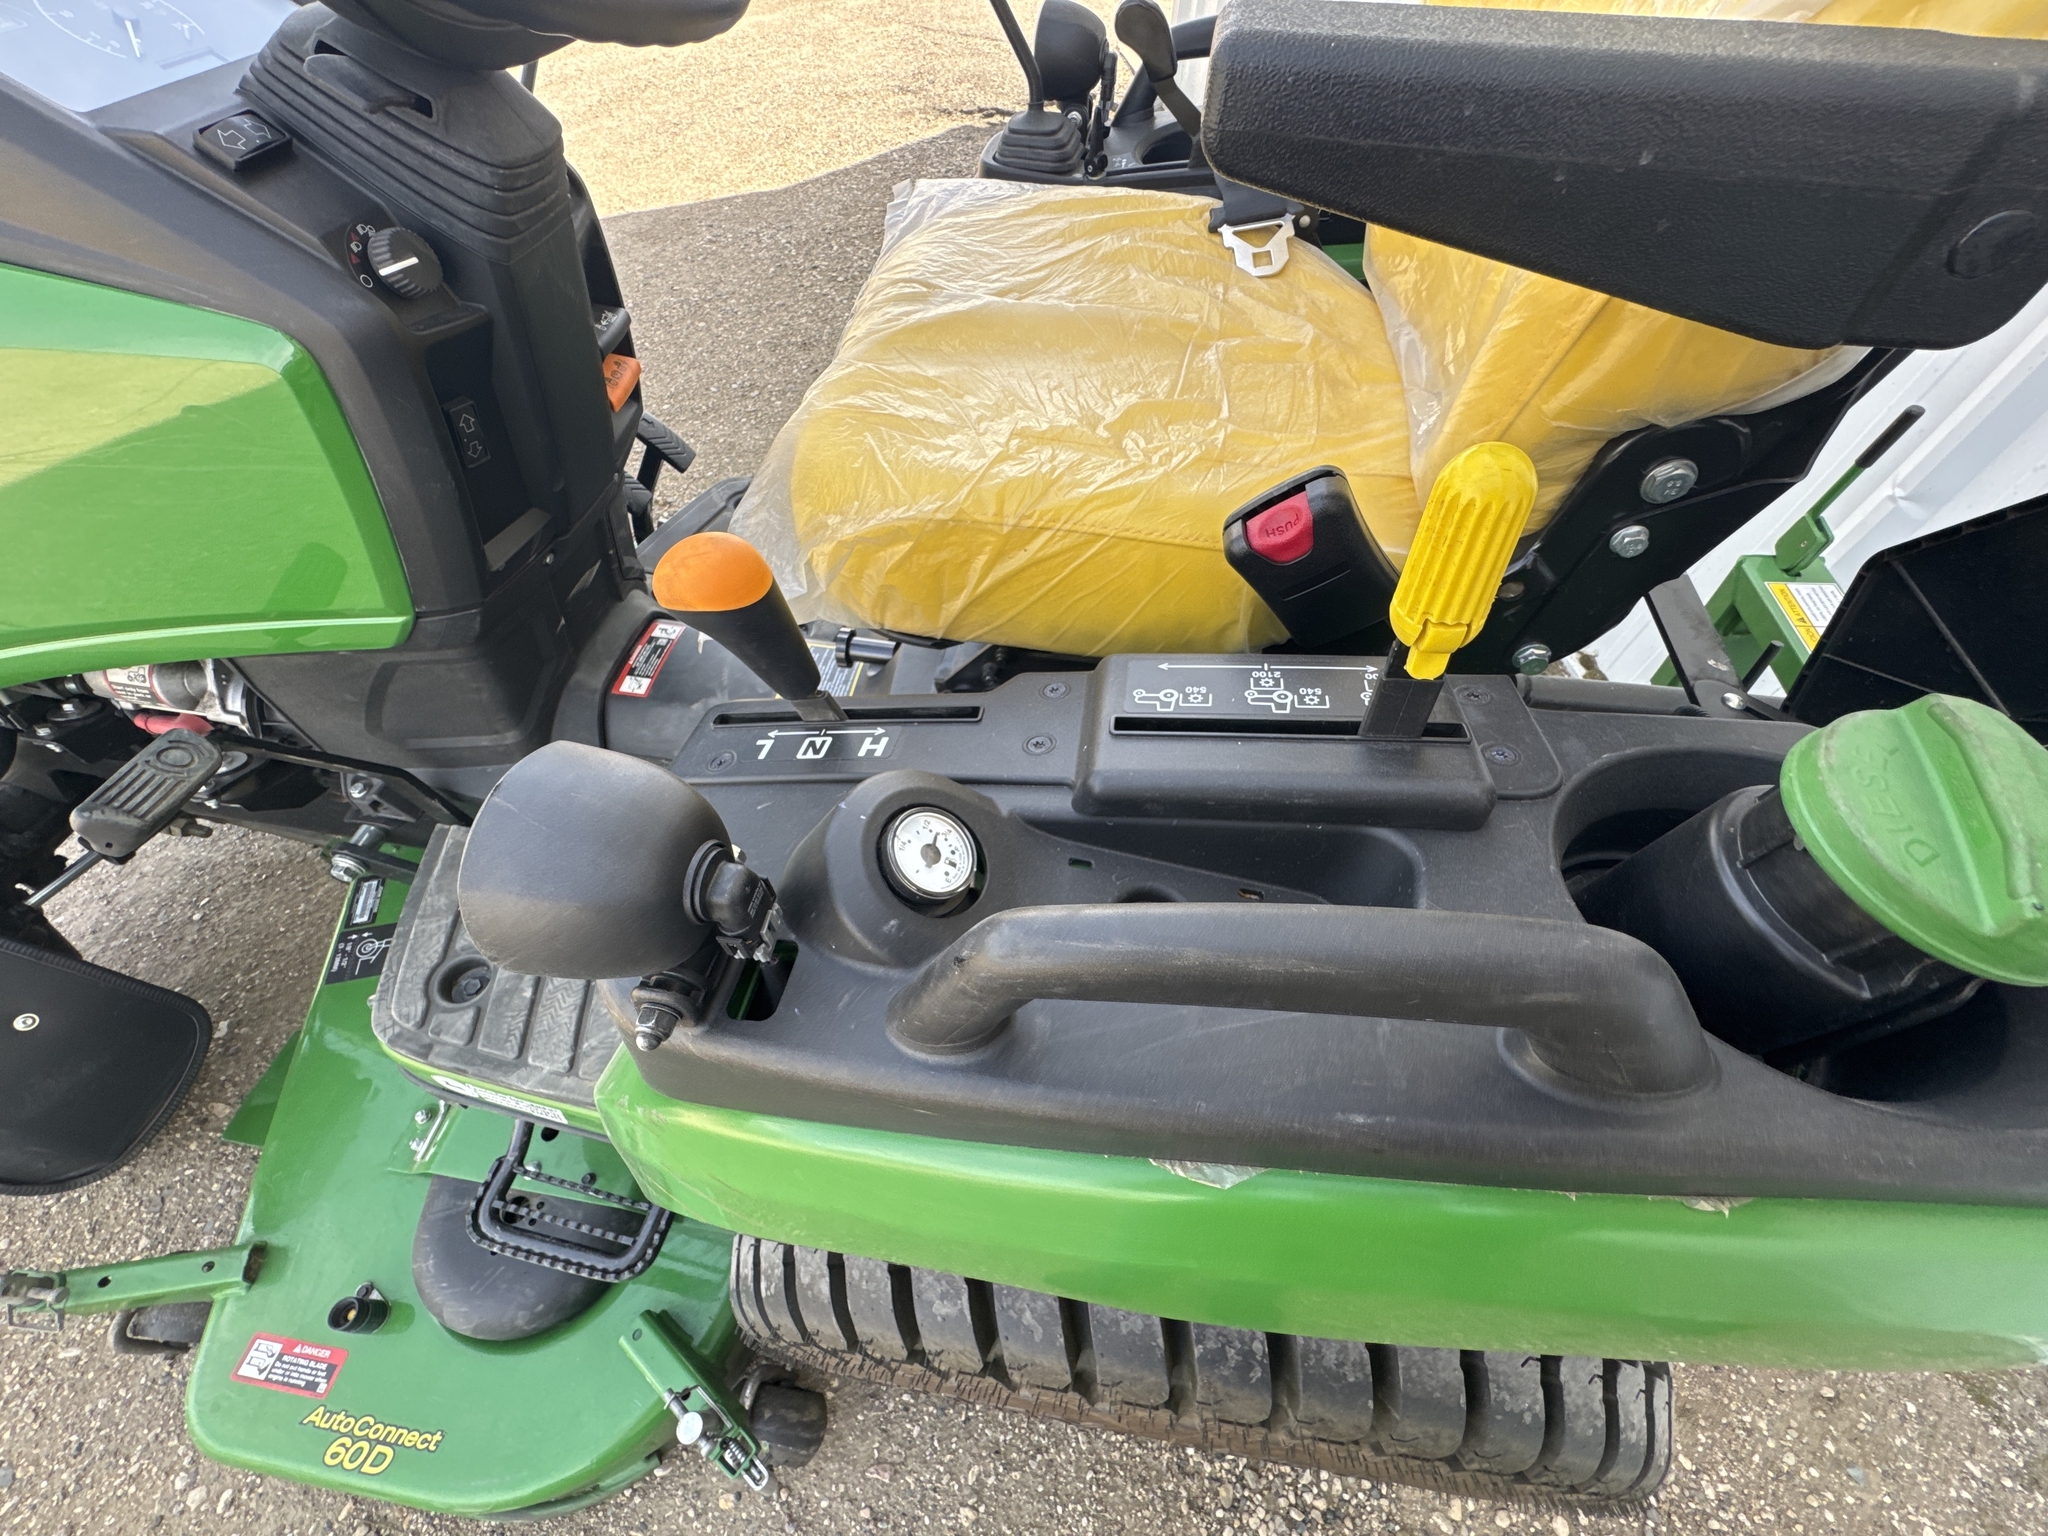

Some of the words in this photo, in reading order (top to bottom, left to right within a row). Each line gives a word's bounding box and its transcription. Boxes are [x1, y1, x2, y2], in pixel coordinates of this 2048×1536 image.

[1264, 513, 1300, 538] PUSH
[1252, 670, 1281, 678] 2100
[1184, 686, 1208, 694] 540
[1299, 687, 1322, 696] 540
[756, 739, 775, 760] L
[800, 738, 830, 757] N
[857, 736, 890, 757] H
[922, 819, 931, 830] 1/2
[941, 828, 952, 837] 3/4
[898, 840, 908, 852] 1/4
[301, 1345, 331, 1358] DANGER
[281, 1355, 310, 1366] ROTATING
[309, 1360, 328, 1370] BLADE
[301, 1405, 444, 1452] AutoConnect
[323, 1436, 395, 1474] 60D
